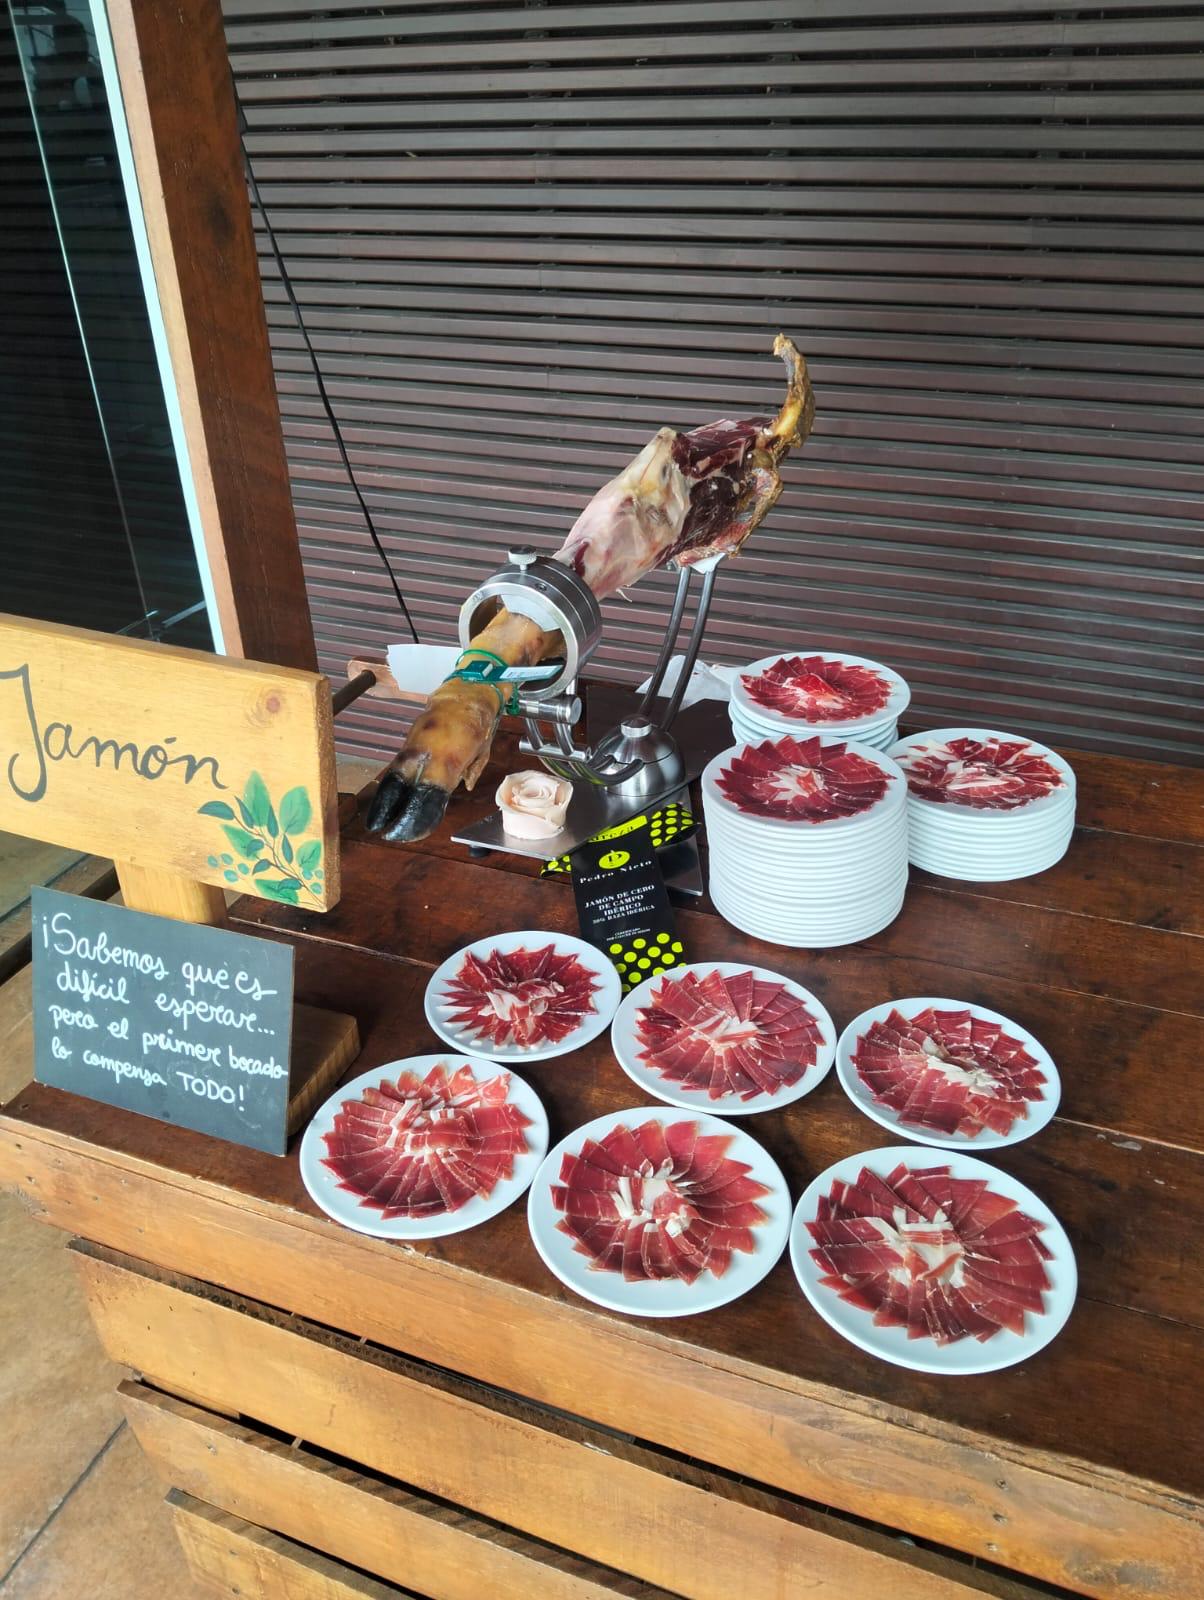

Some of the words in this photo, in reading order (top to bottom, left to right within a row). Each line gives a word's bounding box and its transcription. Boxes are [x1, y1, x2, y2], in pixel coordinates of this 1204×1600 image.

[0, 663, 229, 802] Jamón
[579, 872, 614, 884] Pedro
[620, 860, 652, 872] Nieto
[585, 895, 615, 908] JAMÓN
[616, 892, 629, 900] DE
[631, 884, 655, 895] CEBO
[598, 903, 611, 911] DE
[612, 894, 644, 907] CAMPO
[604, 902, 641, 916] IBÉRICO
[57, 961, 130, 1004] difícil
[235, 970, 278, 1001] es
[49, 1005, 98, 1029] pero
[107, 1017, 129, 1040] el
[143, 1029, 221, 1066] primer
[229, 1046, 288, 1079] bocado
[52, 1036, 72, 1059] lo
[83, 1049, 167, 1086] compensa
[176, 1071, 245, 1112] TODO!
